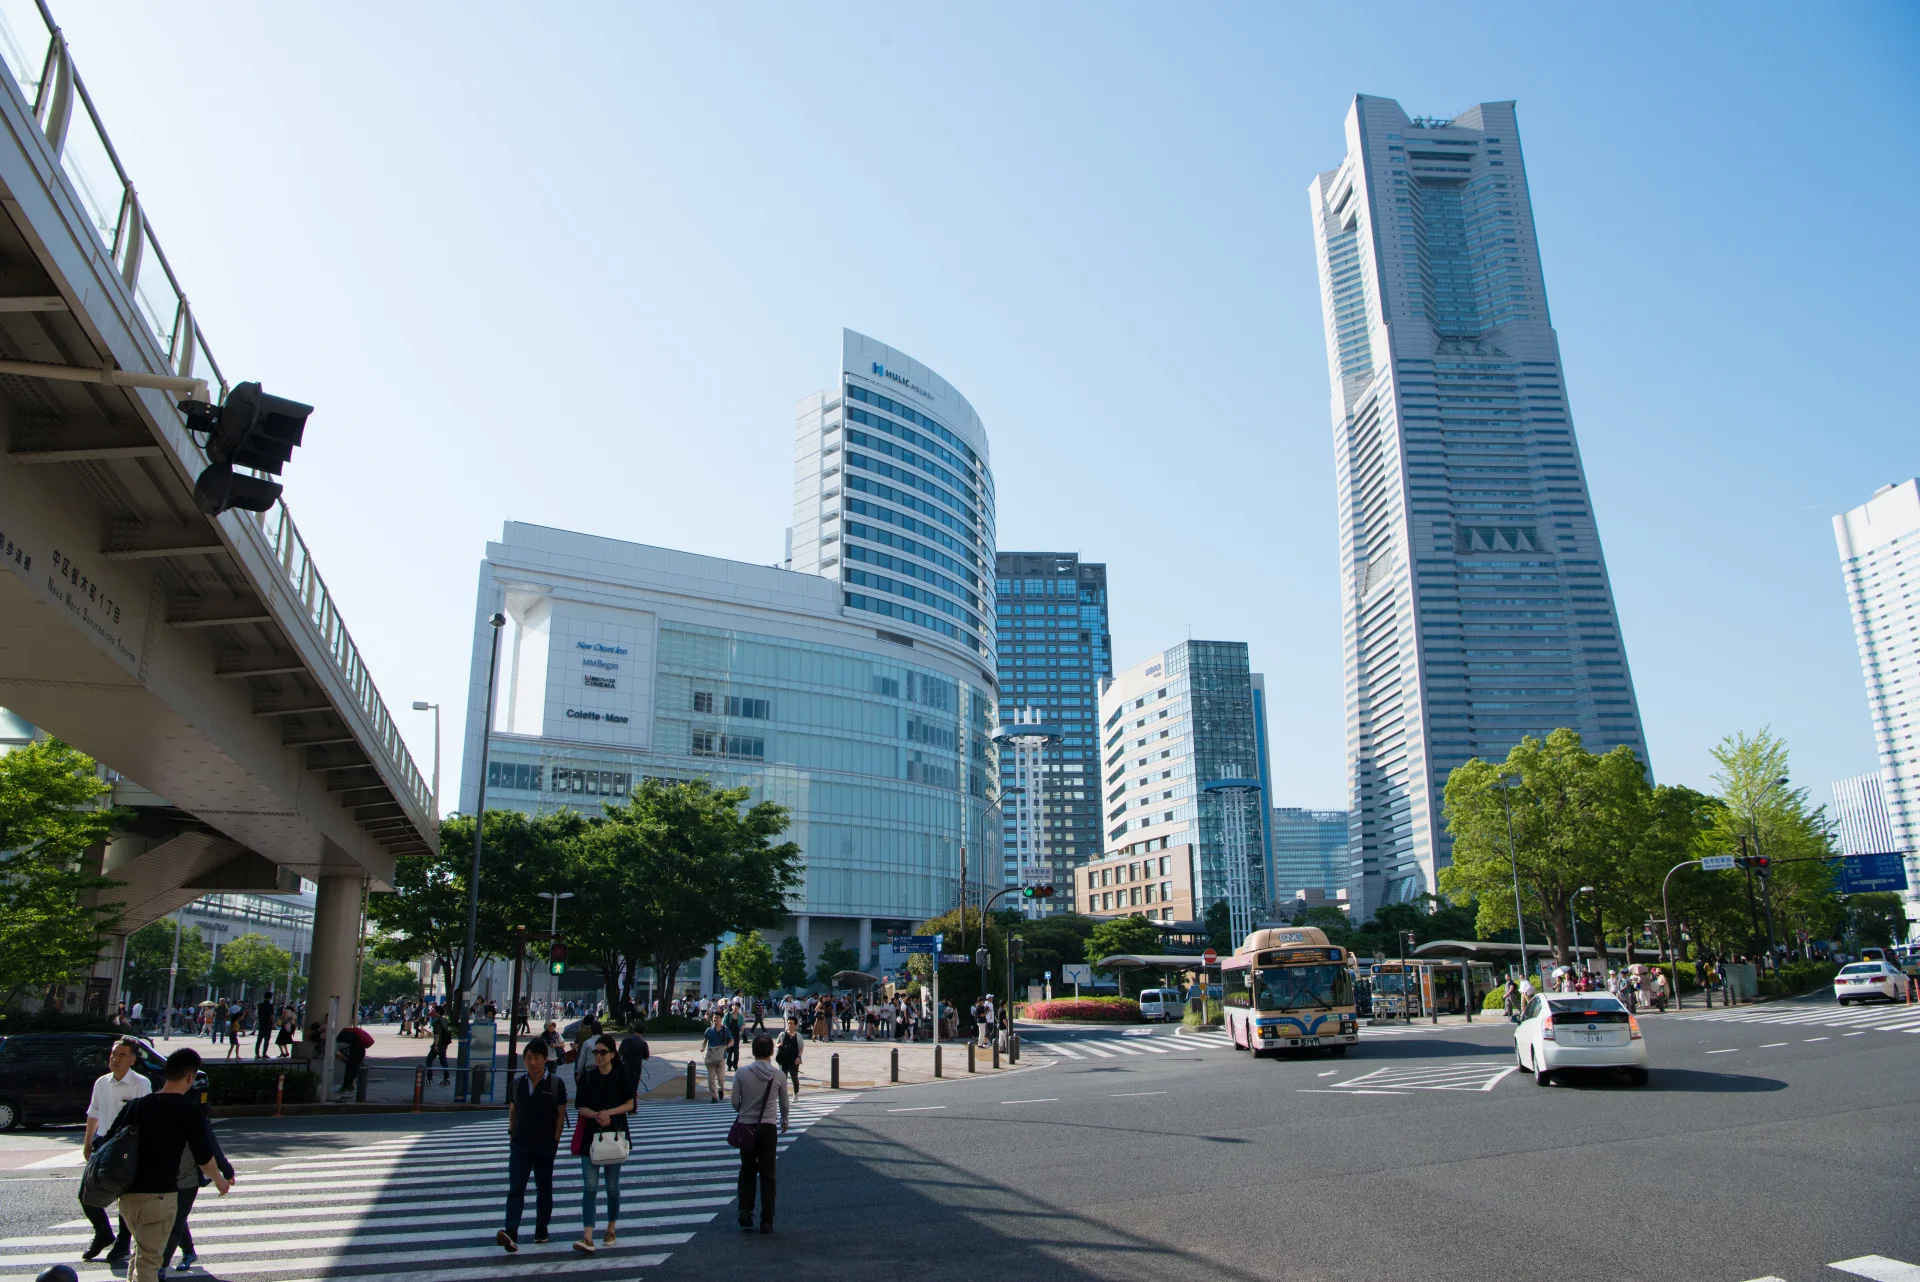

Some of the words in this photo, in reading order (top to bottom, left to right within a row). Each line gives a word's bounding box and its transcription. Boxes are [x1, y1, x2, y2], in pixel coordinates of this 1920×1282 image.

[886, 370, 910, 386] HULIC
[52, 548, 121, 624] 中区桜木町1丁目
[47, 576, 63, 601] Naka
[65, 591, 81, 616] Ward
[576, 641, 592, 650] New
[594, 644, 615, 653] Otani
[615, 646, 628, 654] Inn
[585, 680, 615, 688] CINEMA
[567, 709, 600, 720] Colette
[605, 714, 628, 723] Mare
[1279, 932, 1303, 942] CNG
